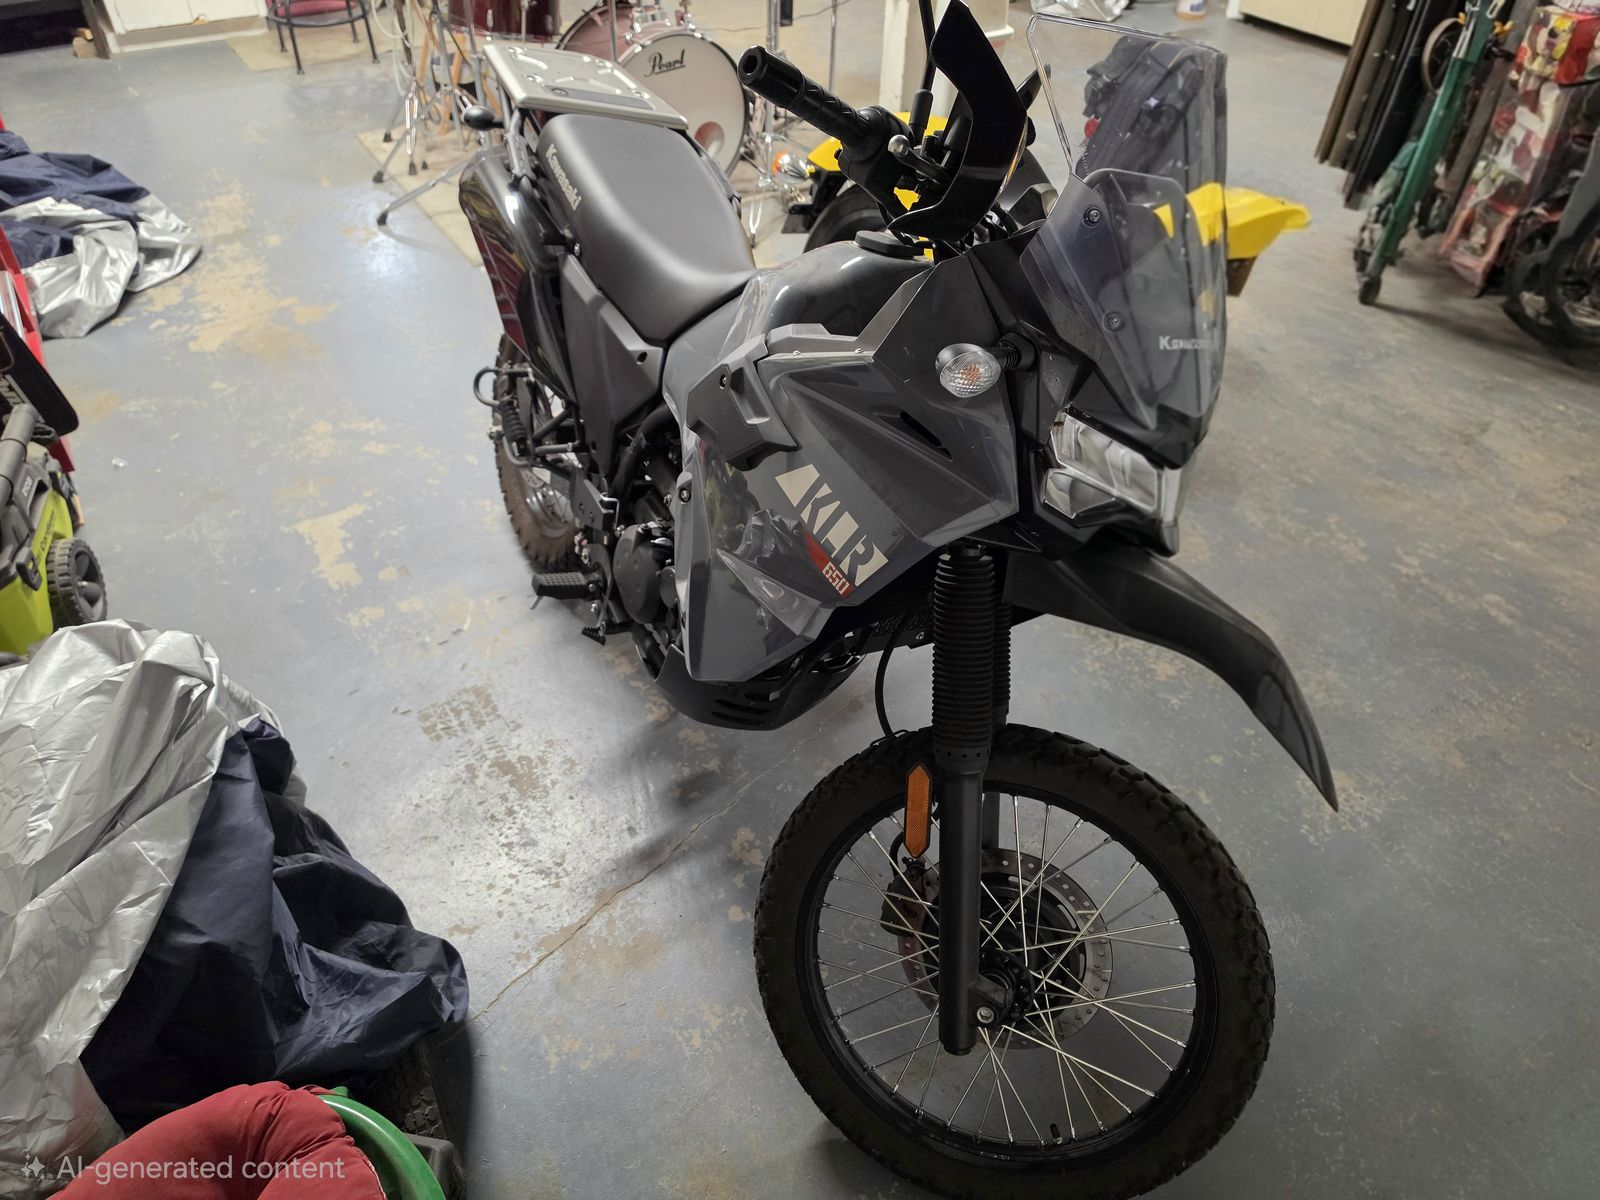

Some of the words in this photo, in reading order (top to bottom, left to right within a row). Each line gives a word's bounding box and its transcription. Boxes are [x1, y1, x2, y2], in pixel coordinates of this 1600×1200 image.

[644, 49, 686, 78] Pearl
[545, 143, 582, 211] Kawasaki
[775, 464, 888, 587] KLR
[821, 560, 850, 596] 650
